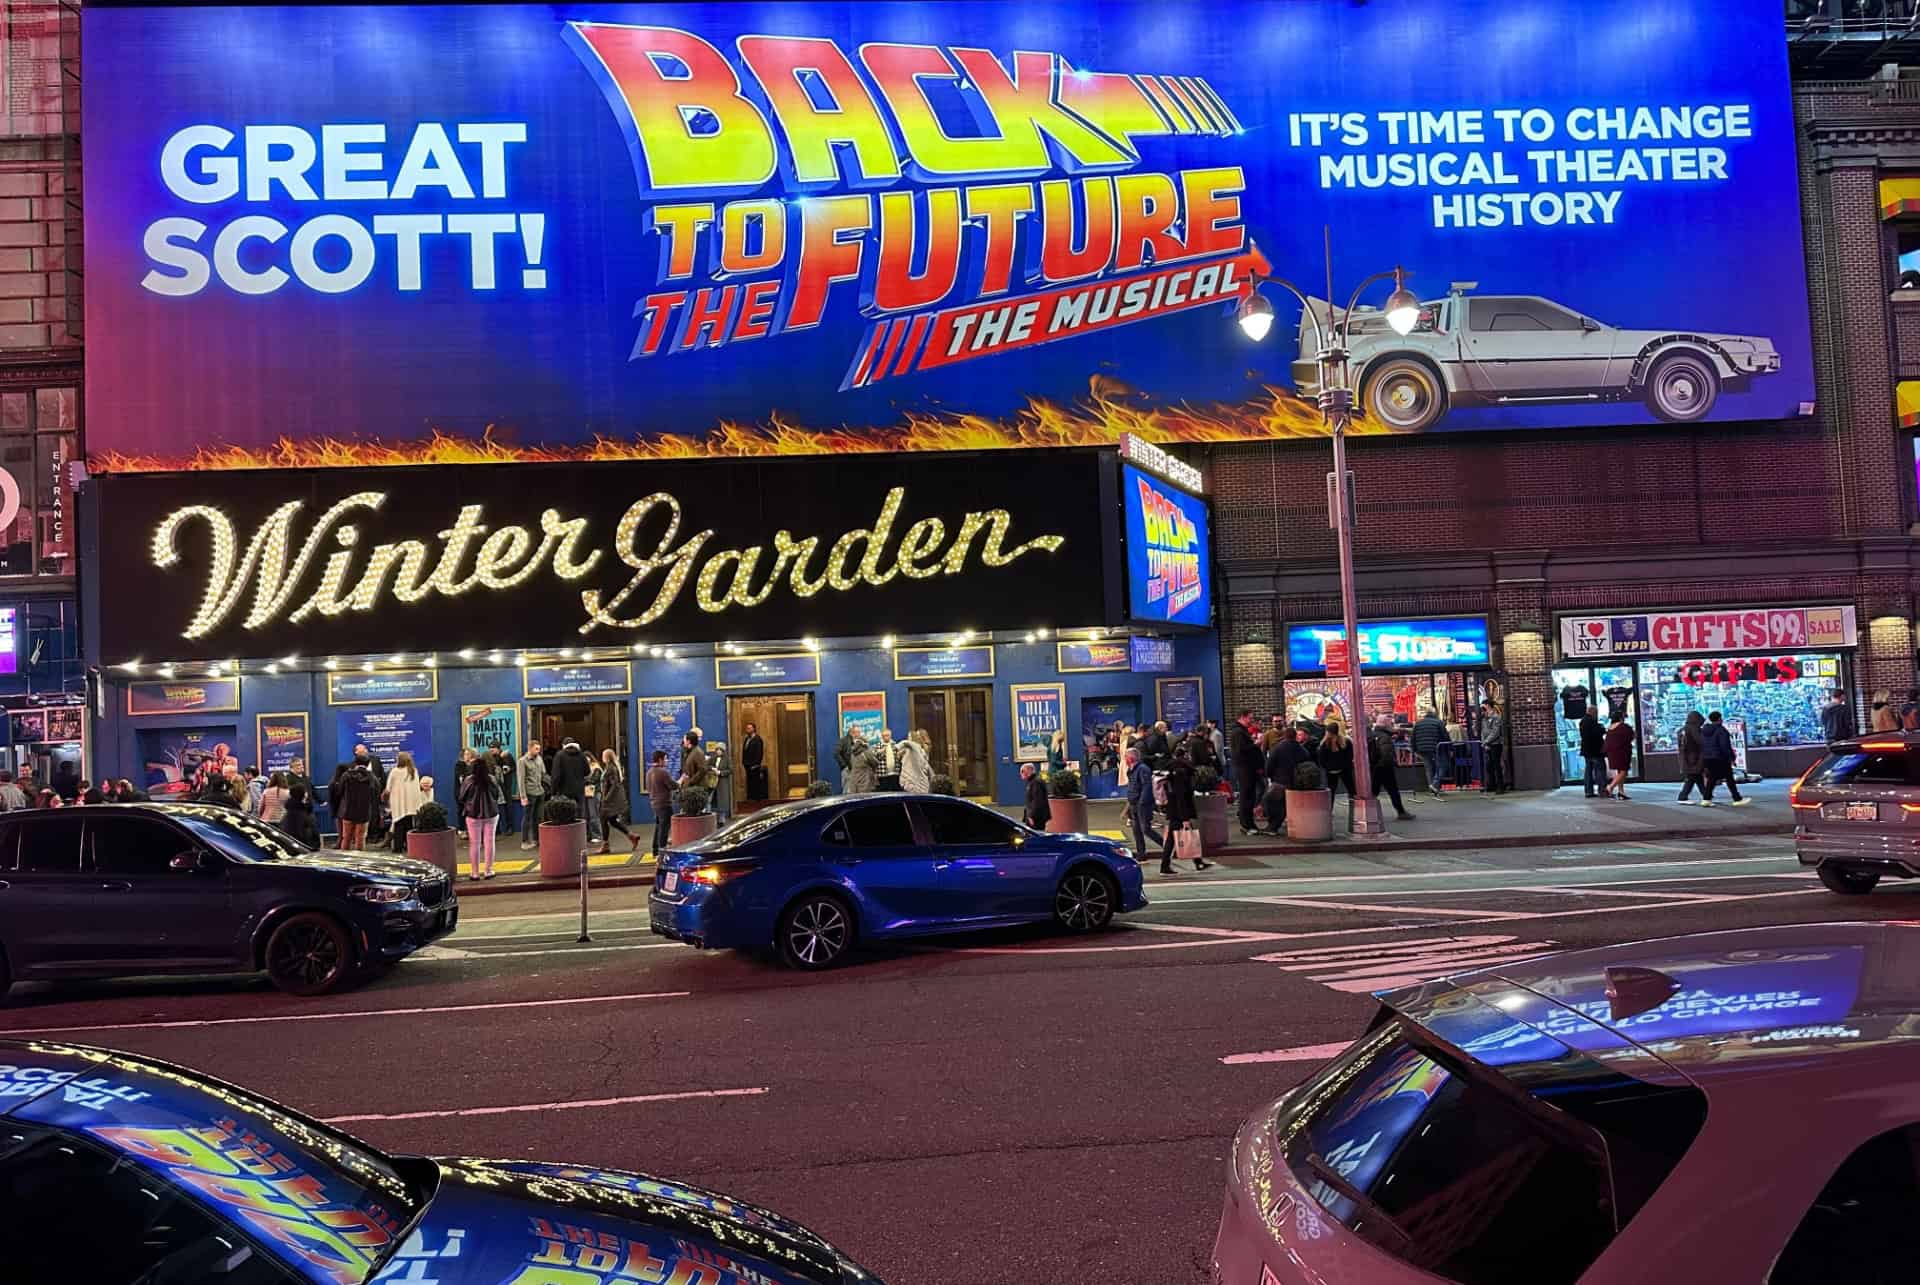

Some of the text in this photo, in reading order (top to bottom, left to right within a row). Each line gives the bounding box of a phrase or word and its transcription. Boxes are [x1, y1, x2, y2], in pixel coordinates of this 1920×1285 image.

[565, 20, 1243, 199] BACK
[1289, 104, 1752, 147] IT’S TIME TO CHANGE
[160, 123, 527, 204] GREAT
[1319, 147, 1729, 188] MUSICAL THEATER
[1432, 191, 1623, 227] HISTORY
[140, 213, 547, 296] SCOTT!
[644, 166, 1246, 333] TO FUTURE
[629, 280, 781, 360] THE
[945, 262, 1241, 357] THE MUSICAL
[52, 451, 63, 543] ENTRANCE
[1137, 476, 1199, 552] BACK
[151, 491, 602, 640] Winter
[578, 486, 1065, 636] Garden
[1578, 623, 1587, 637] I
[1578, 638, 1606, 651] NY
[1614, 640, 1648, 651] NYPD
[1652, 611, 1768, 650] GIFTS
[1809, 619, 1841, 635] SALE
[1312, 629, 1371, 666] TE
[1378, 634, 1456, 663] STORE
[1680, 656, 1798, 687] GIFTS
[473, 718, 512, 733] MARTY
[1019, 715, 1057, 730] VALLEY
[1025, 701, 1052, 716] HILL
[474, 732, 512, 748] McFLY
